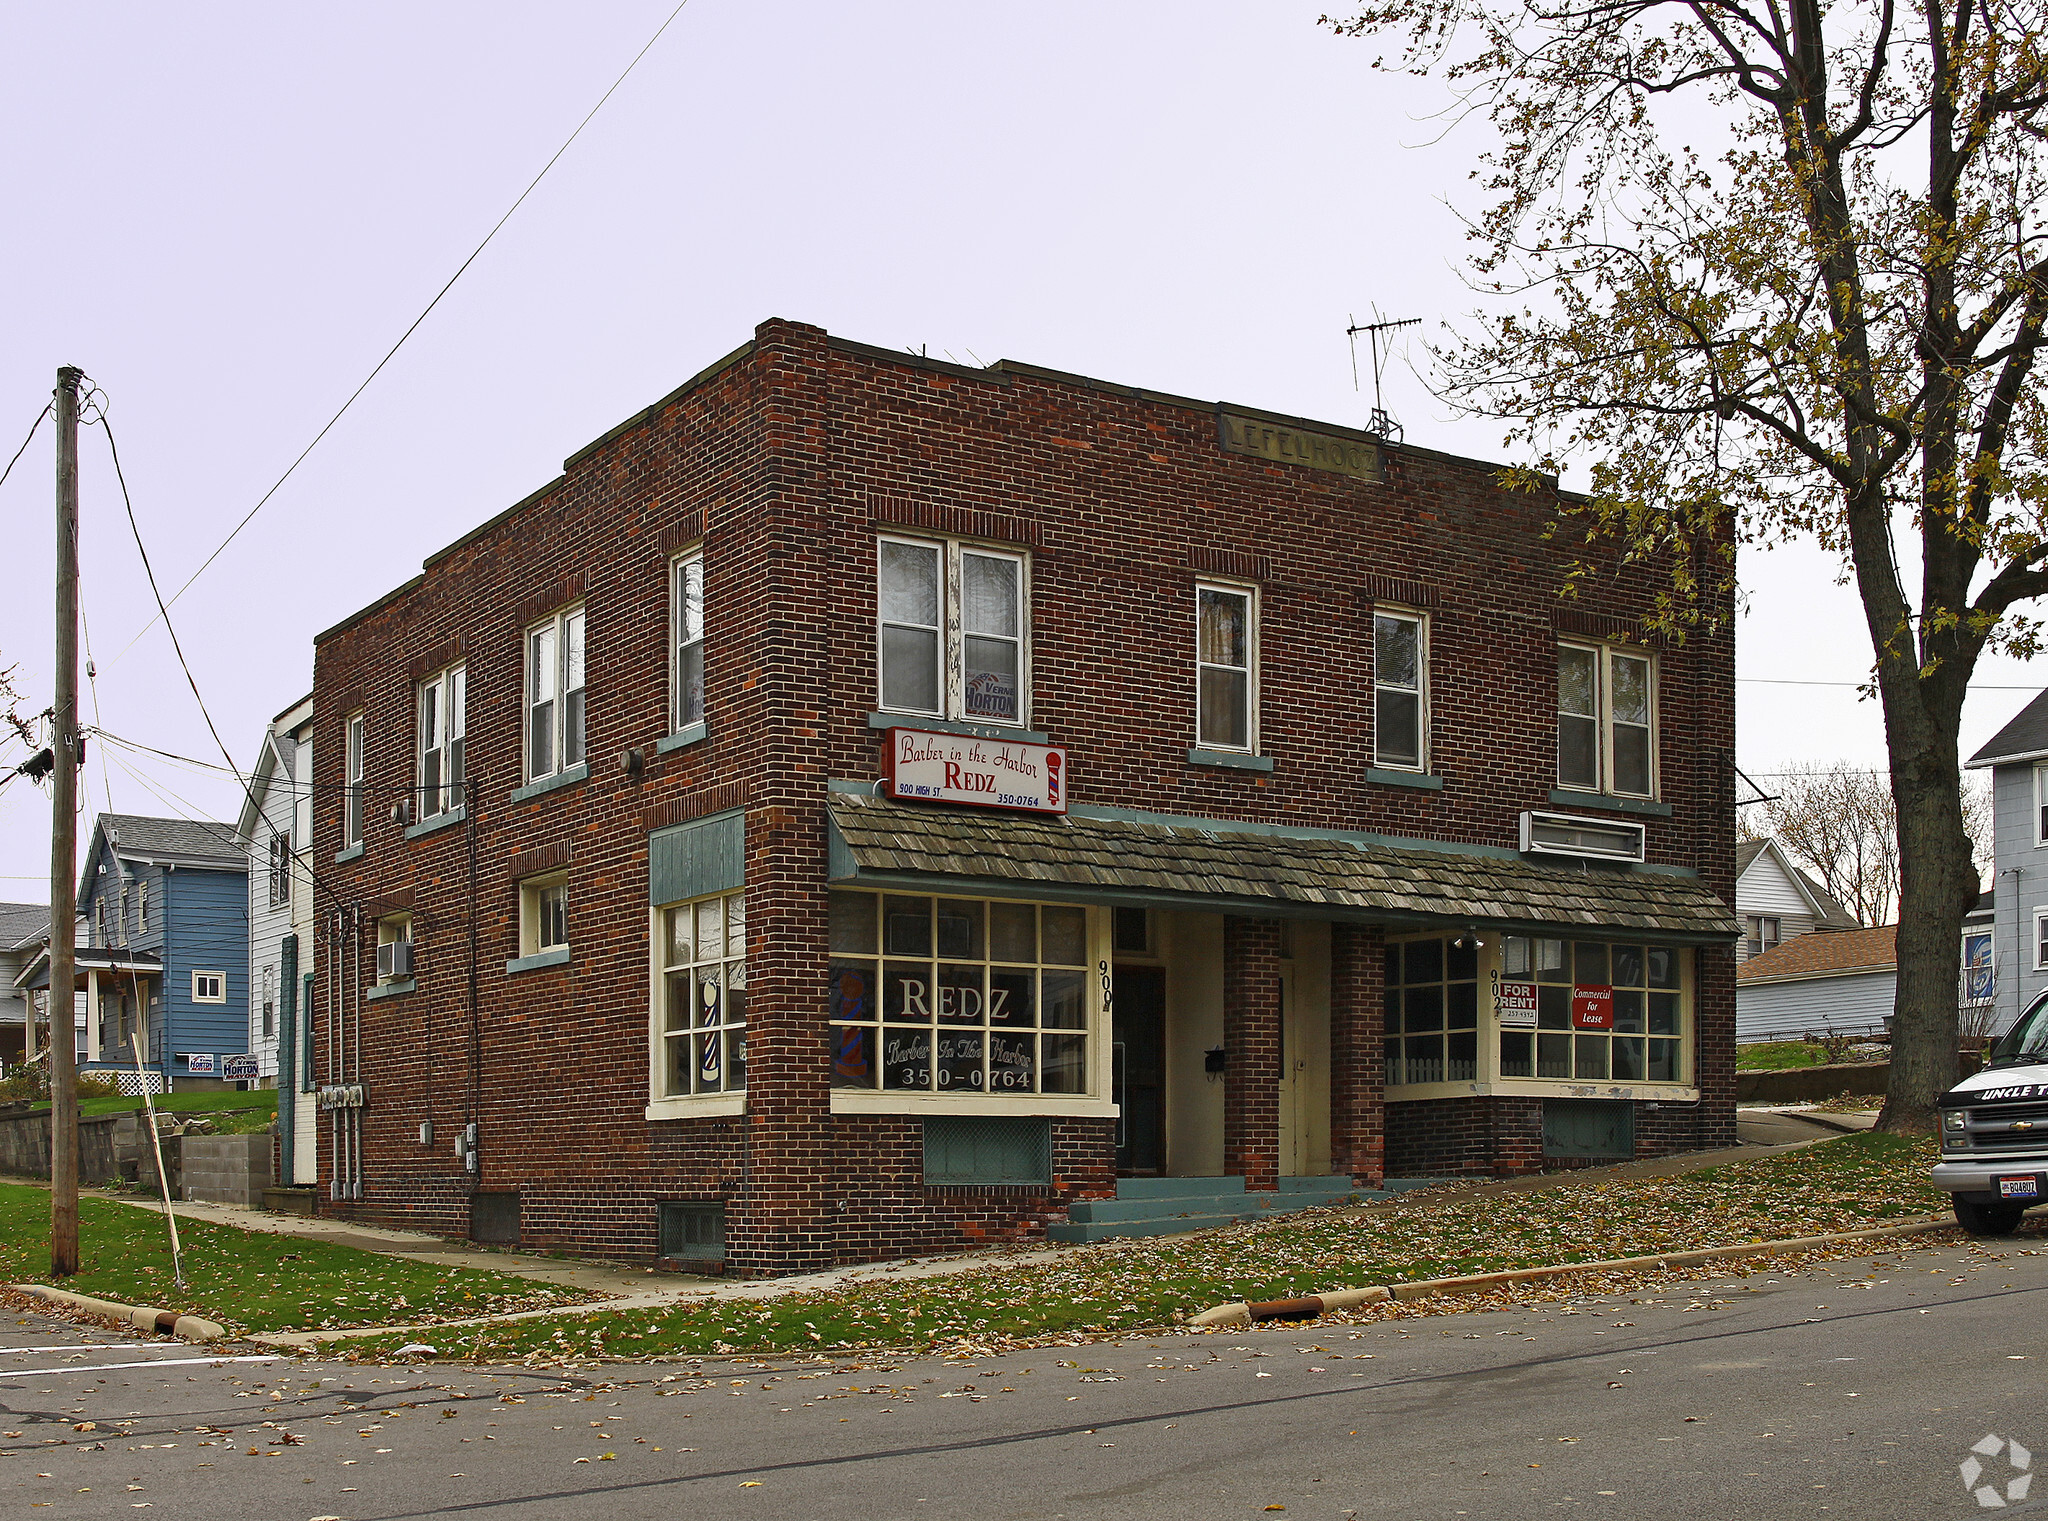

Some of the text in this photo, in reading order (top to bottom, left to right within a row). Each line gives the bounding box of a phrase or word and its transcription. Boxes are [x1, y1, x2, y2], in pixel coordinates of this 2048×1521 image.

[966, 687, 1015, 712] HORTON
[900, 735, 1038, 779] Barber in the Harbor
[943, 761, 997, 794] REDZ
[900, 783, 943, 798] 900 HIGH ST.
[998, 793, 1039, 807] 350-0764
[1490, 969, 1501, 1009] 902
[1503, 985, 1531, 997] FOR
[1574, 988, 1611, 999] Commercial
[898, 978, 1010, 1019] REDZ
[1500, 996, 1535, 1009] RENT
[1587, 1001, 1598, 1011] For
[1582, 1013, 1603, 1024] Lease
[887, 1035, 1032, 1068] Barber In The Harbor
[224, 1064, 258, 1075] HORTON
[902, 1068, 1030, 1088] 350-0764
[1981, 1086, 2032, 1100] UNCLE
